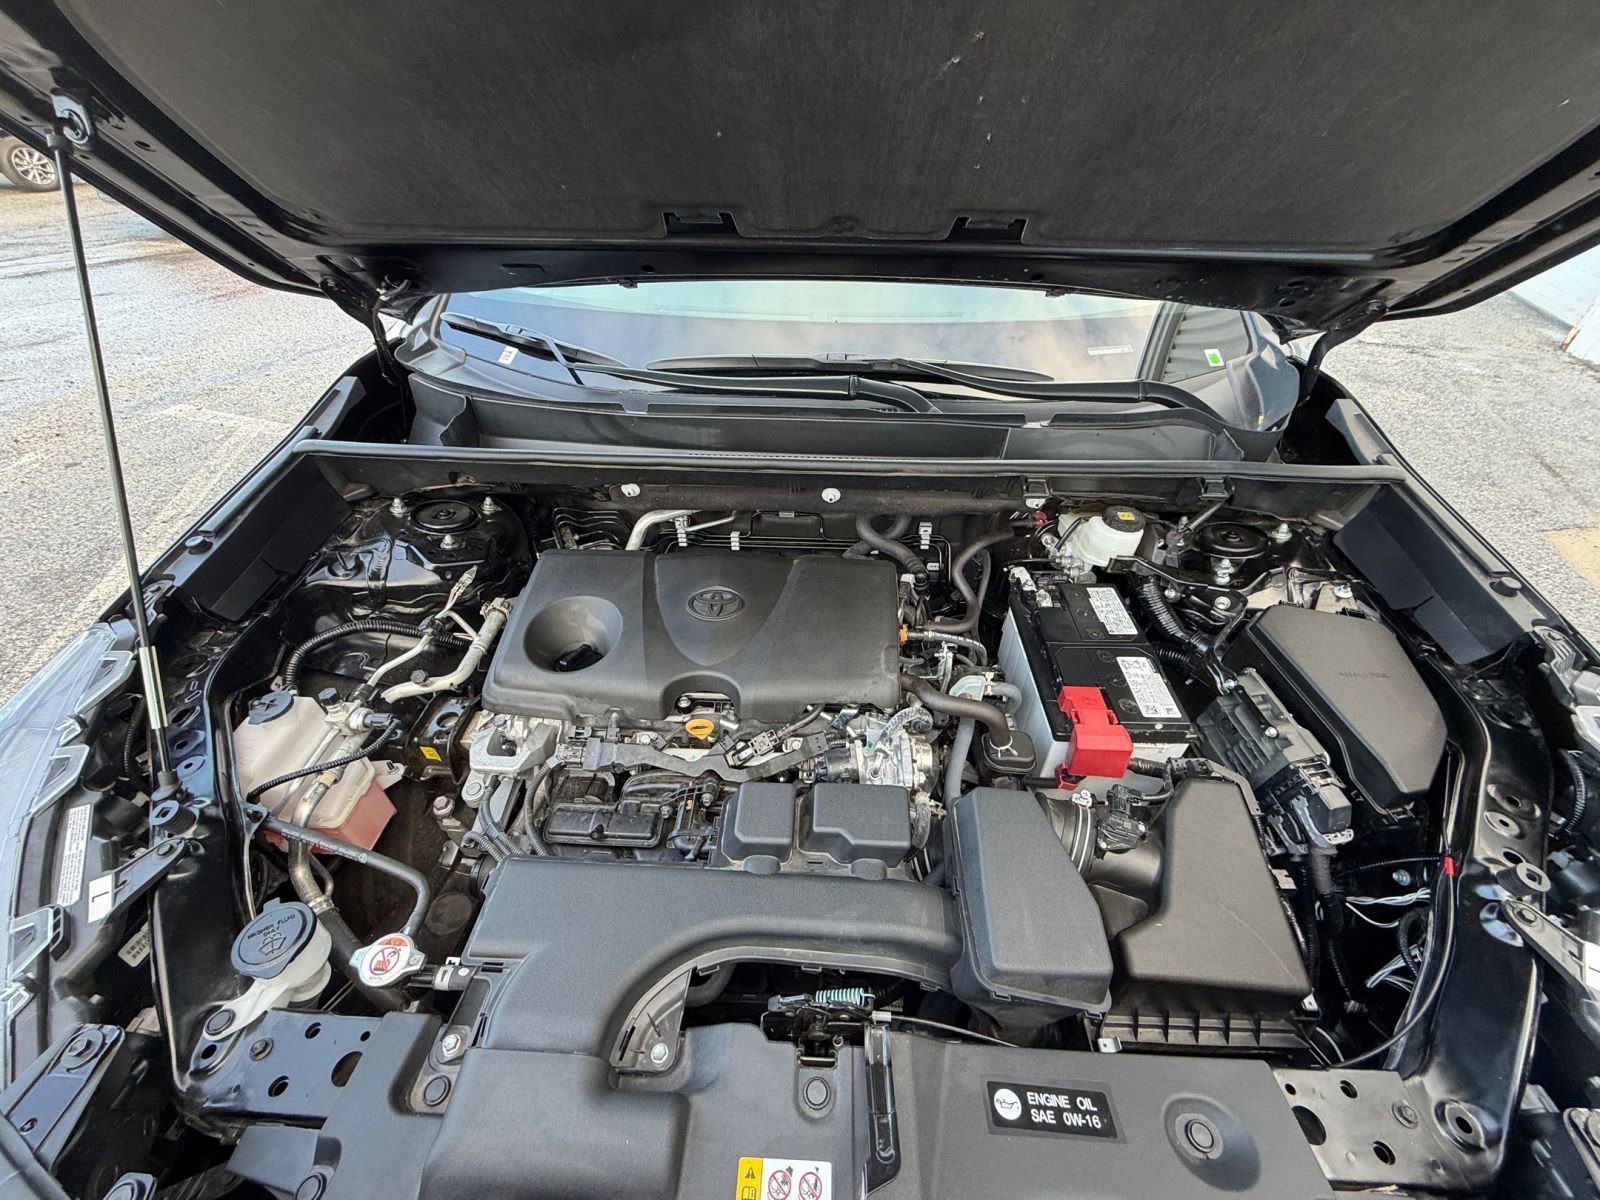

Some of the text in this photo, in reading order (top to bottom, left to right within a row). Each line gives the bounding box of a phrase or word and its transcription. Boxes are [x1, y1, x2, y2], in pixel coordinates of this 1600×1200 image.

[277, 914, 296, 927] FLUID
[1026, 1091, 1098, 1112] ENGINE OIL
[1030, 1108, 1102, 1129] SAE 0W-16
